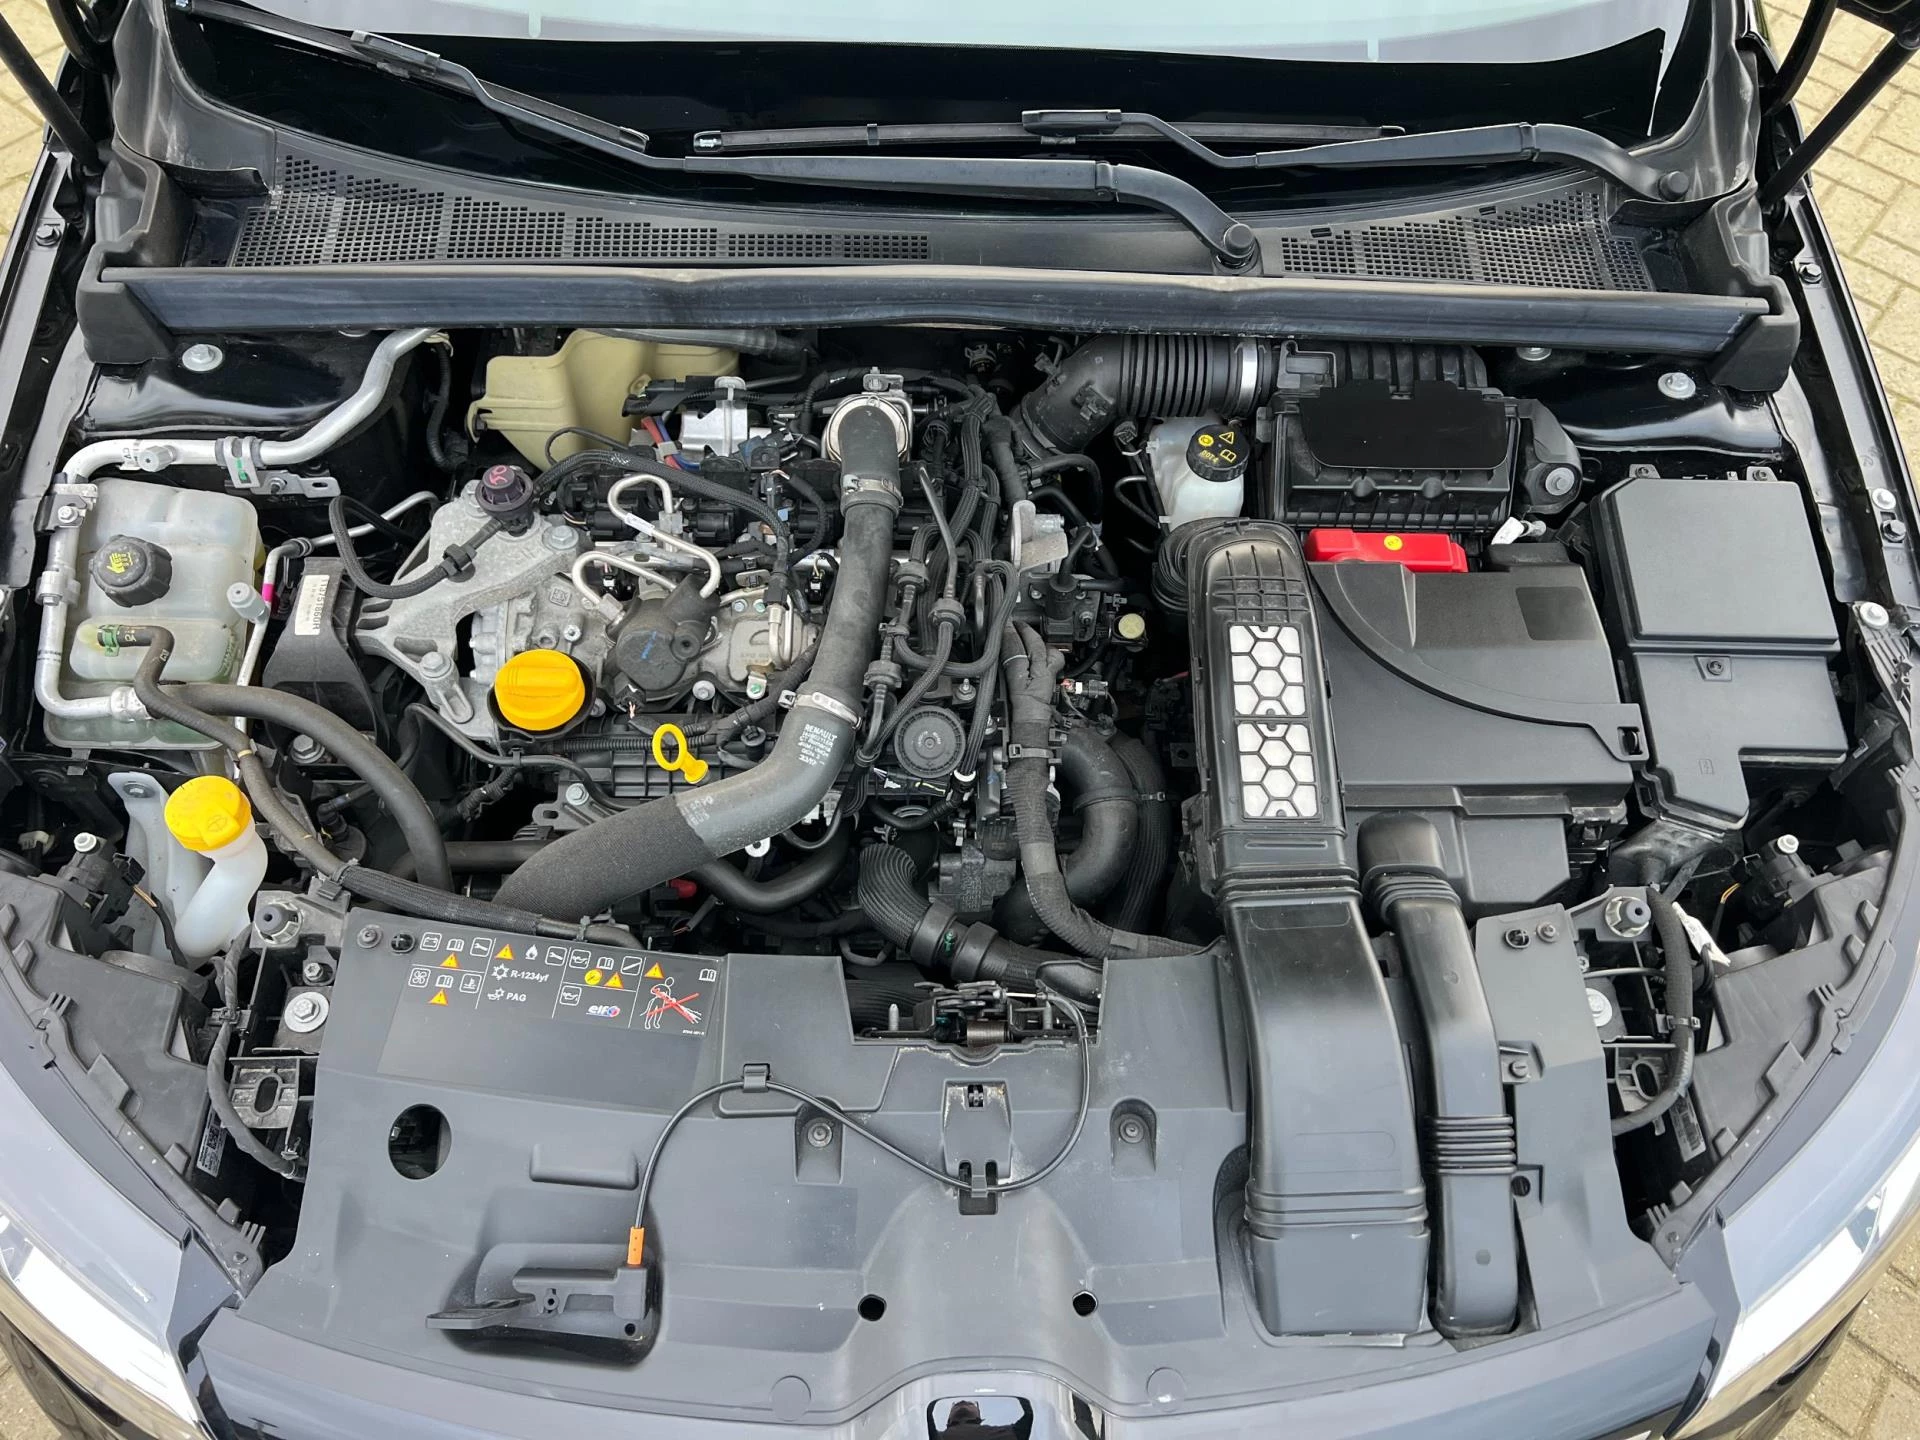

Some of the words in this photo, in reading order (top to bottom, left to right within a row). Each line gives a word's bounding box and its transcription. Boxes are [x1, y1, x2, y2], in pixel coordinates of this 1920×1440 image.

[804, 723, 838, 741] RENAULT
[510, 969, 549, 983] R-1234yf
[506, 992, 527, 1002] PAG
[587, 1005, 609, 1016] elf
